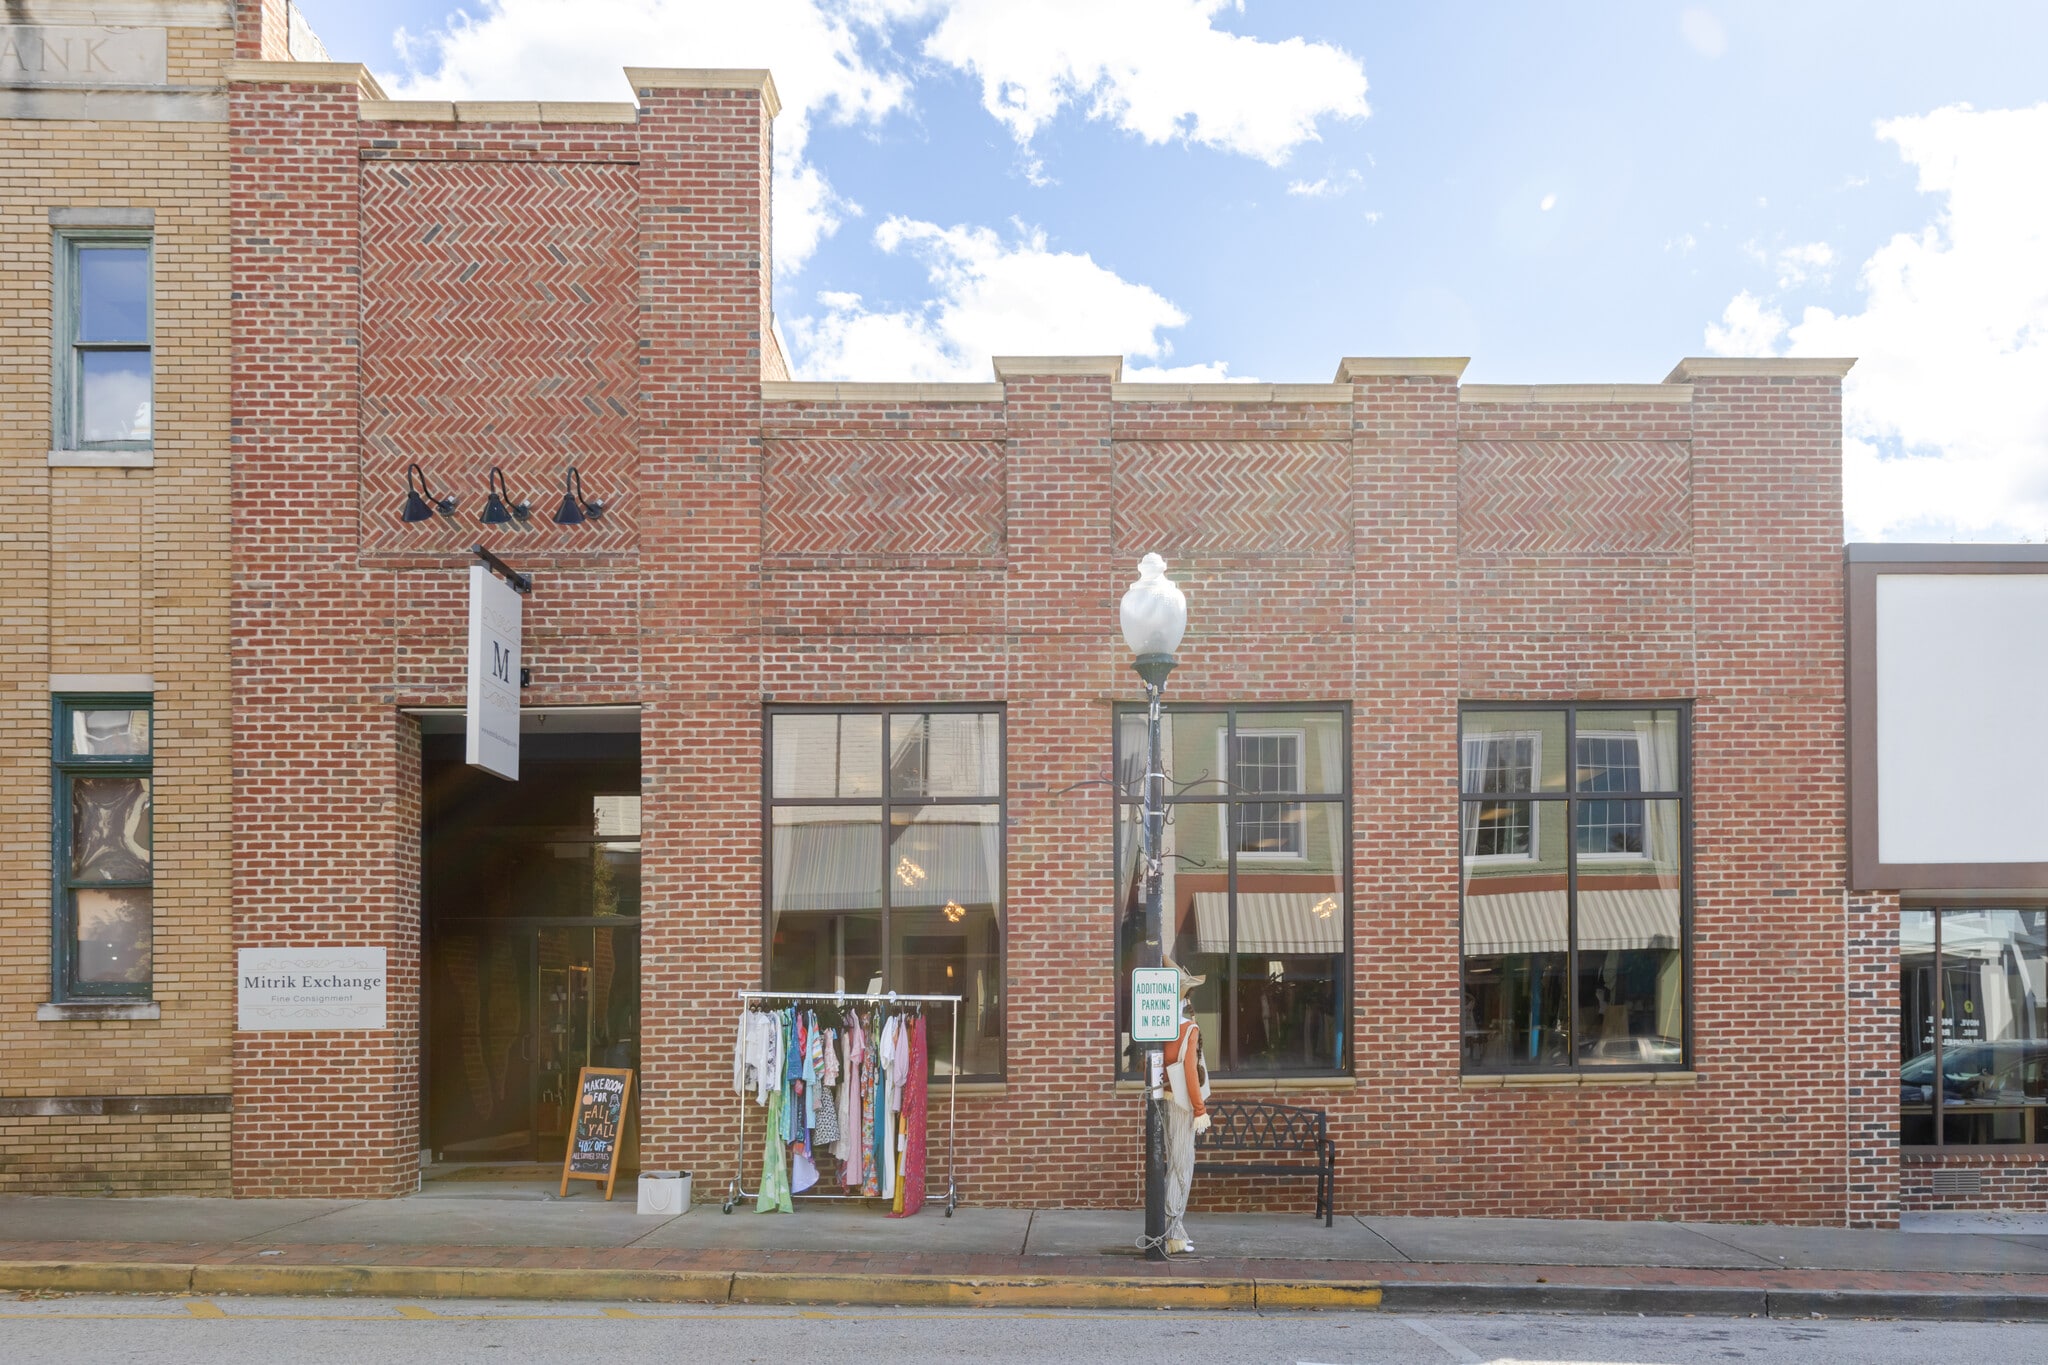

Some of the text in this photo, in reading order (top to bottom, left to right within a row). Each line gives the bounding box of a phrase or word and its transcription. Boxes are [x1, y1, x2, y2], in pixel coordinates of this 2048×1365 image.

[492, 640, 510, 683] M
[244, 975, 381, 990] Mitrik Exchange
[1136, 983, 1176, 994] ADDITIONAL
[293, 995, 353, 1003] Consignment
[1141, 1000, 1170, 1011] PARKING
[1141, 1016, 1171, 1027] IN REAR
[584, 1078, 624, 1094] MAKE ROOM
[593, 1093, 607, 1102] FOR
[584, 1105, 610, 1124] FALL
[588, 1124, 615, 1138] Y'ALL
[579, 1141, 607, 1152] 40% OFF
